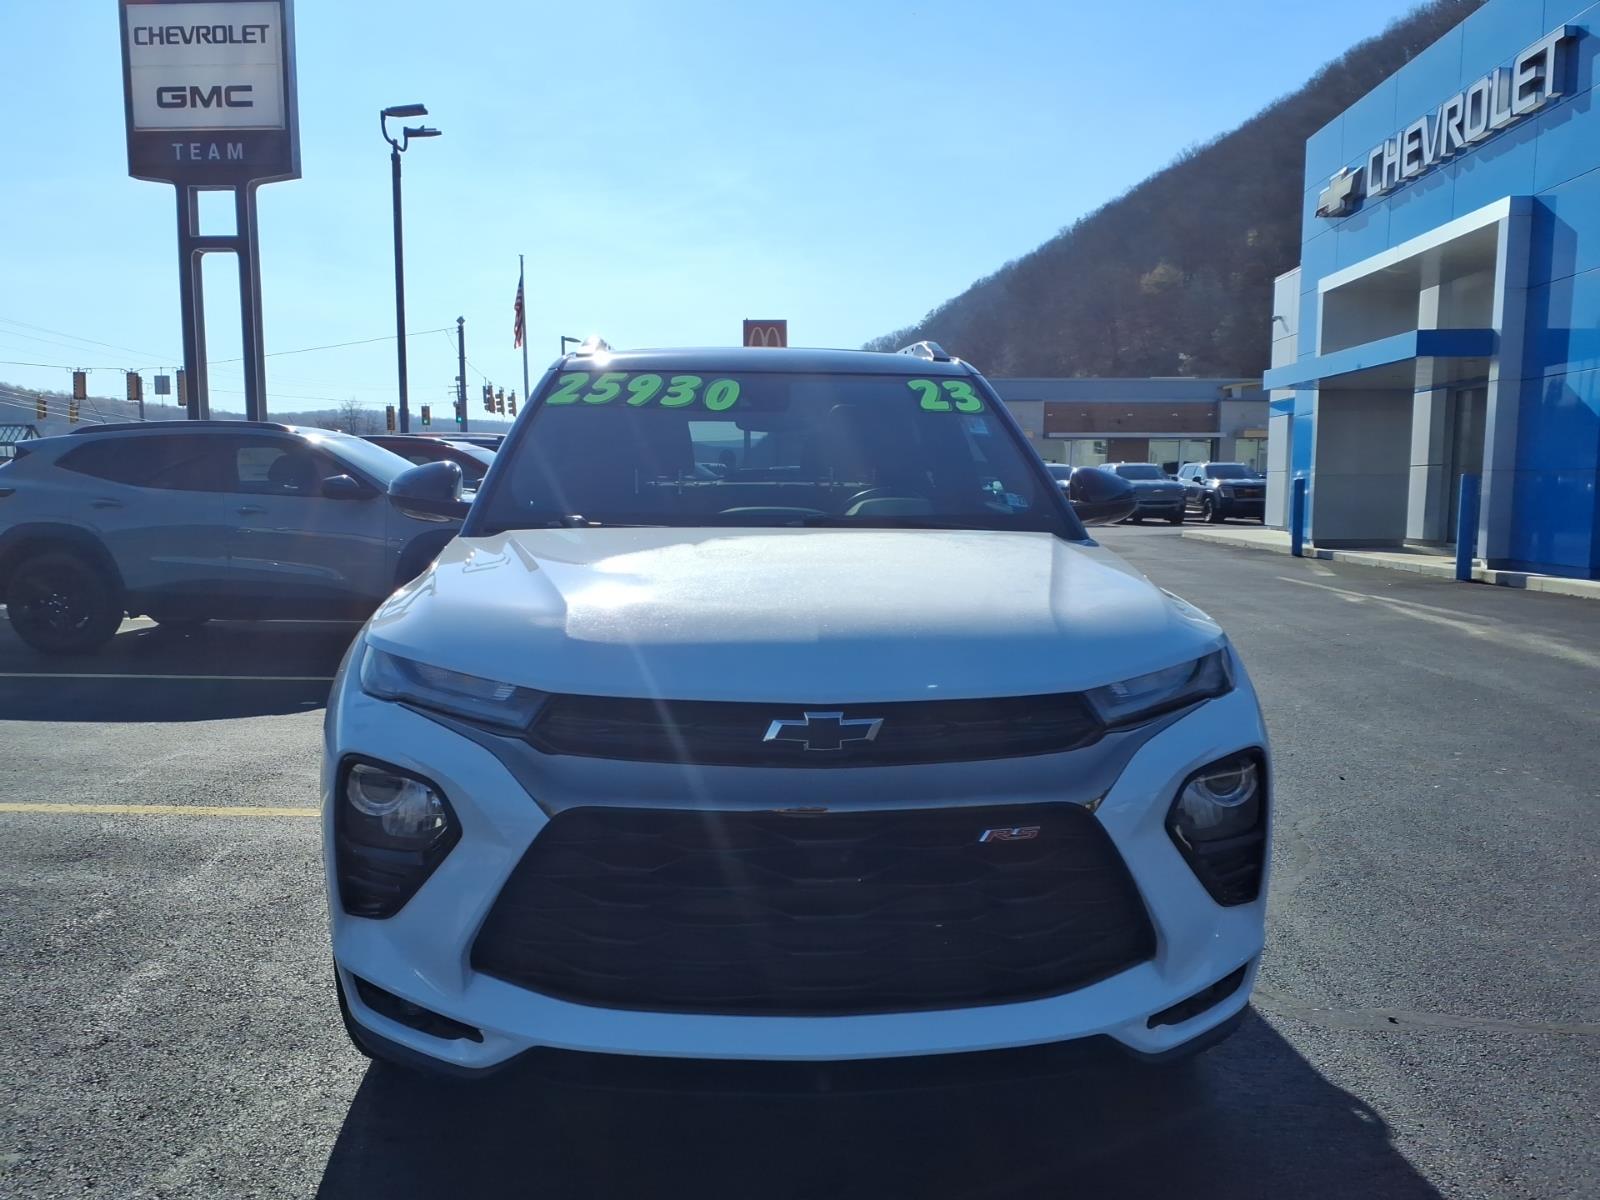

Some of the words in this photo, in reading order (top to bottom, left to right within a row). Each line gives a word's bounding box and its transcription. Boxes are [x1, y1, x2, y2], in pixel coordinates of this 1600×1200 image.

[133, 24, 270, 46] CHEVROLET
[156, 84, 254, 109] GMC
[1366, 24, 1580, 199] CHEVROLET
[172, 142, 244, 161] TEAM
[546, 371, 742, 412] 25930
[906, 378, 984, 413] 23
[978, 825, 1041, 842] RS
